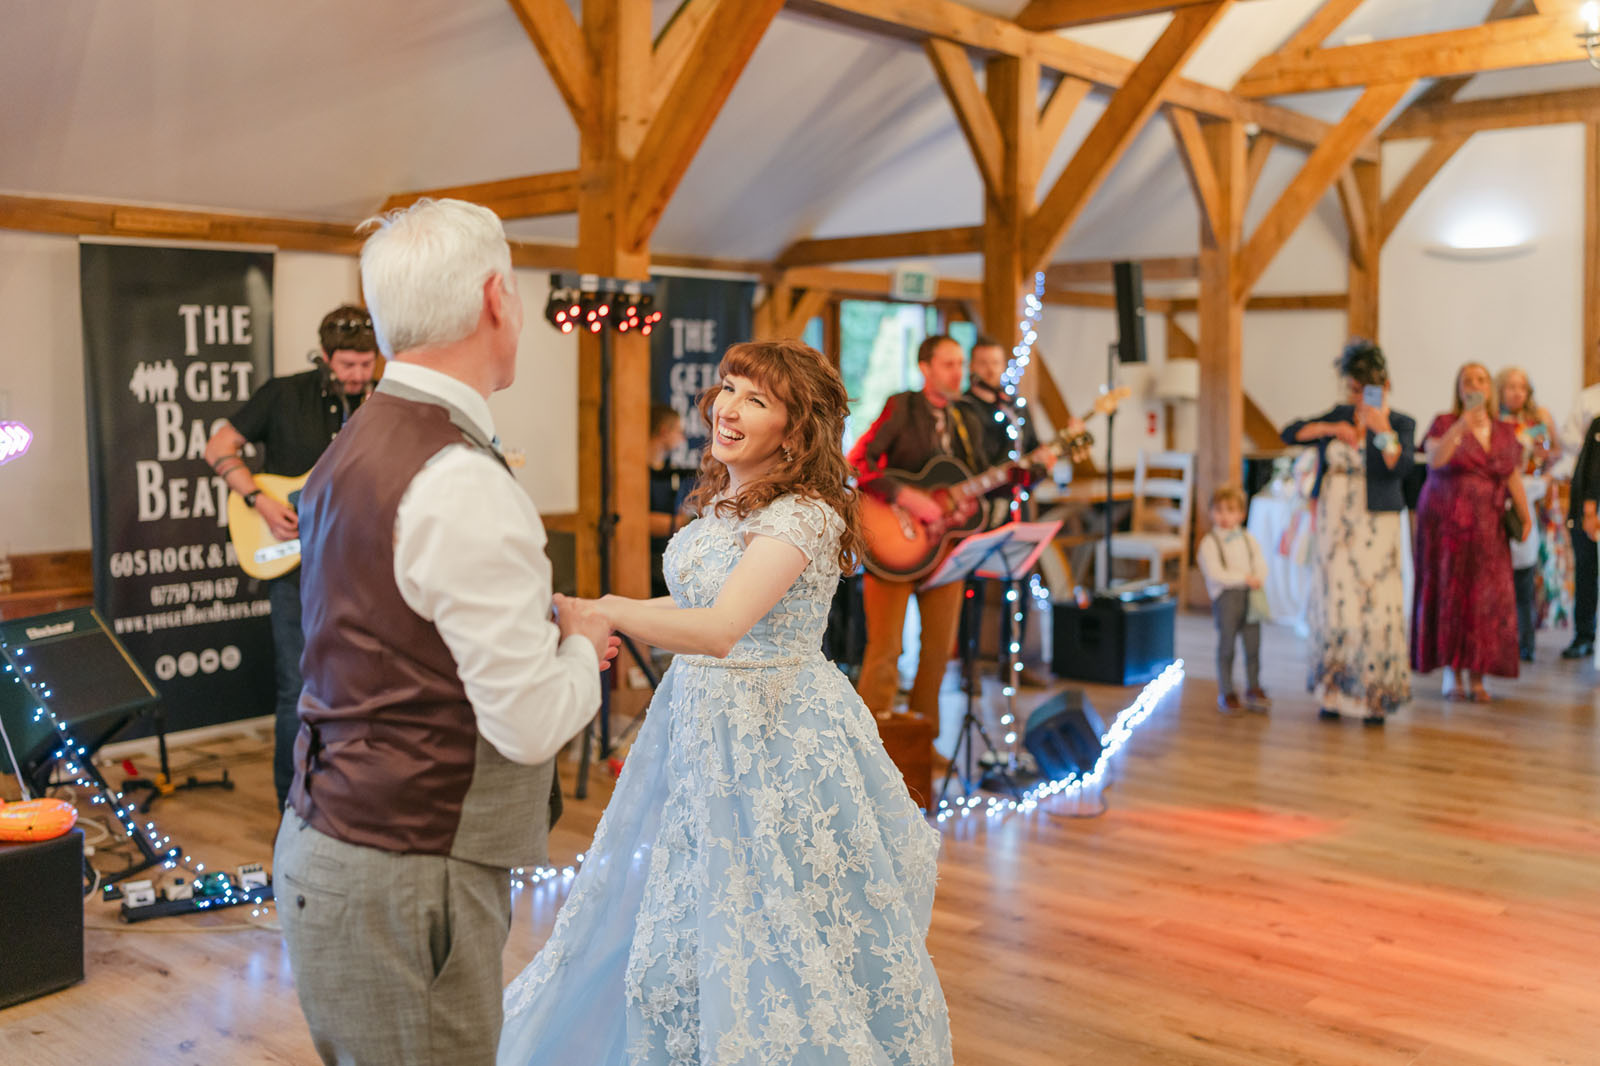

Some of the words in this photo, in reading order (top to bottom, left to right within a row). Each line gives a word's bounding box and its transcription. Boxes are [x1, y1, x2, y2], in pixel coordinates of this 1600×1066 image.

[178, 304, 253, 356] THE
[670, 318, 718, 359] THE
[184, 360, 254, 402] GET
[136, 459, 229, 528] BEAT
[149, 544, 205, 575] ROCK
[206, 542, 224, 569] &
